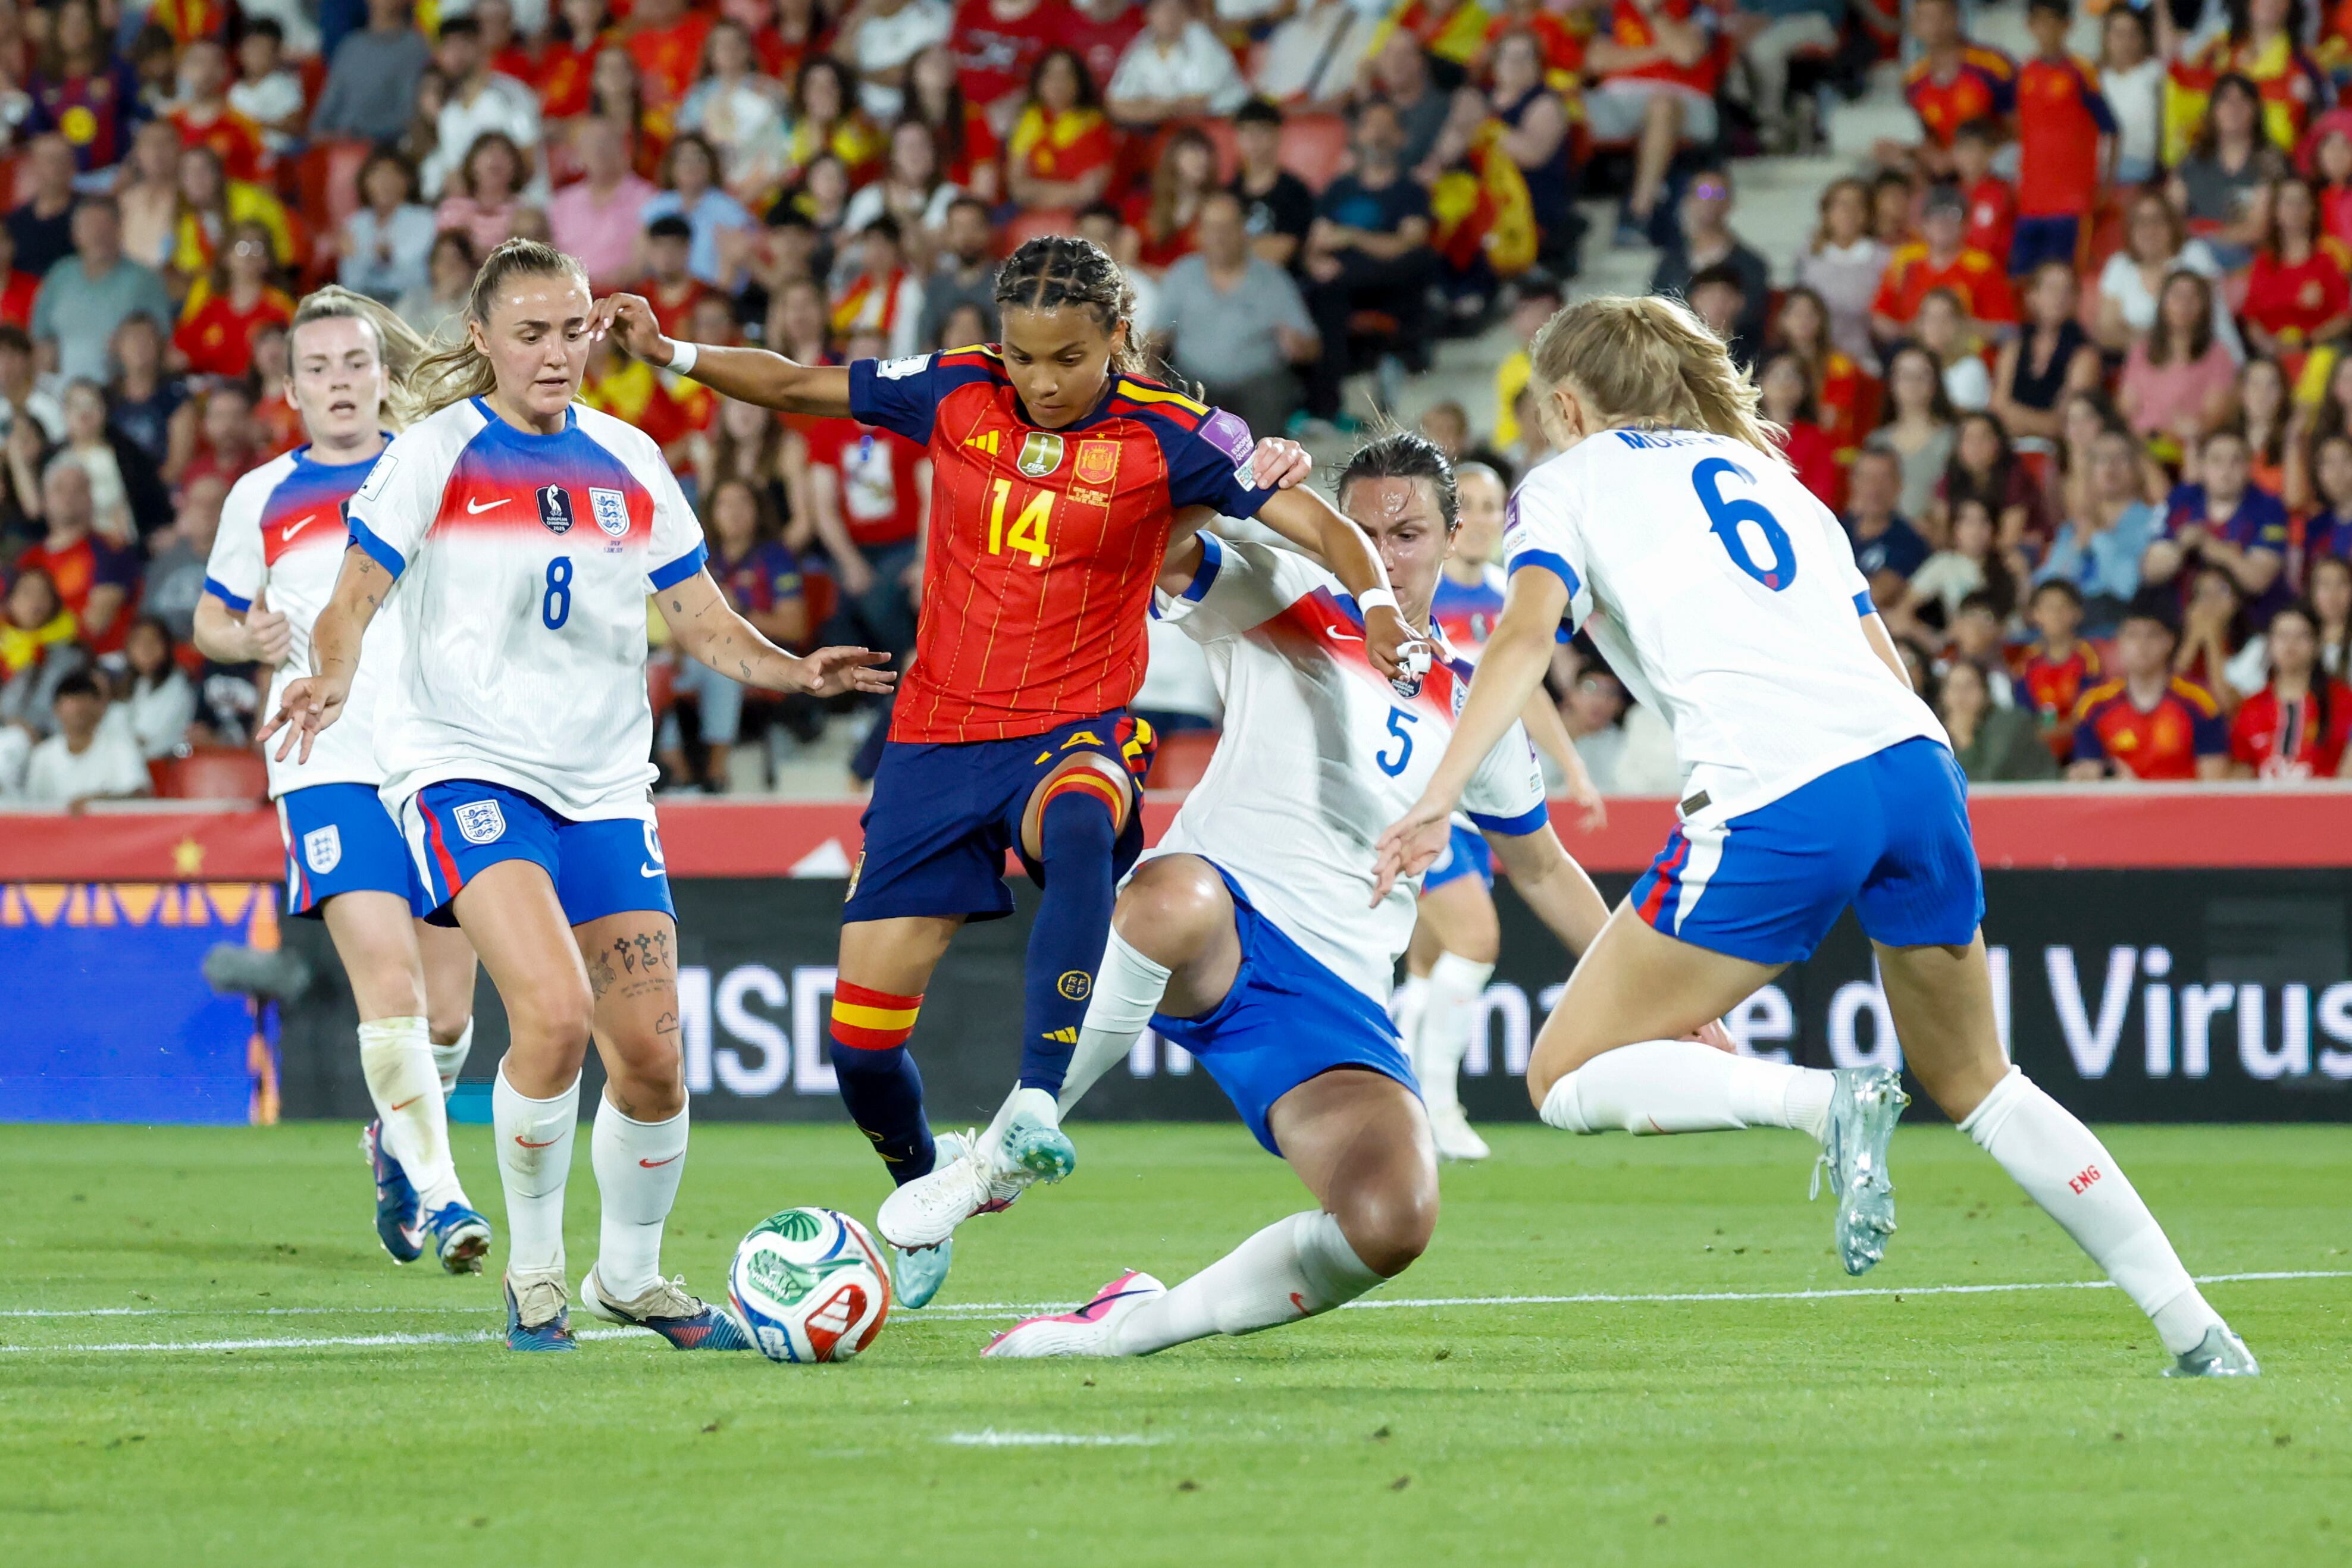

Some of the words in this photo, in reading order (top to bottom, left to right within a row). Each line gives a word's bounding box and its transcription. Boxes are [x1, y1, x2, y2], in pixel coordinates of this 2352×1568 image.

[988, 479, 1056, 566] 14
[1692, 457, 1797, 592] 6
[542, 556, 573, 630] 8
[1376, 704, 1418, 779] 5
[1828, 945, 2011, 1071] dl
[2044, 944, 2352, 1079] Virus
[2068, 1164, 2101, 1195] ENG
